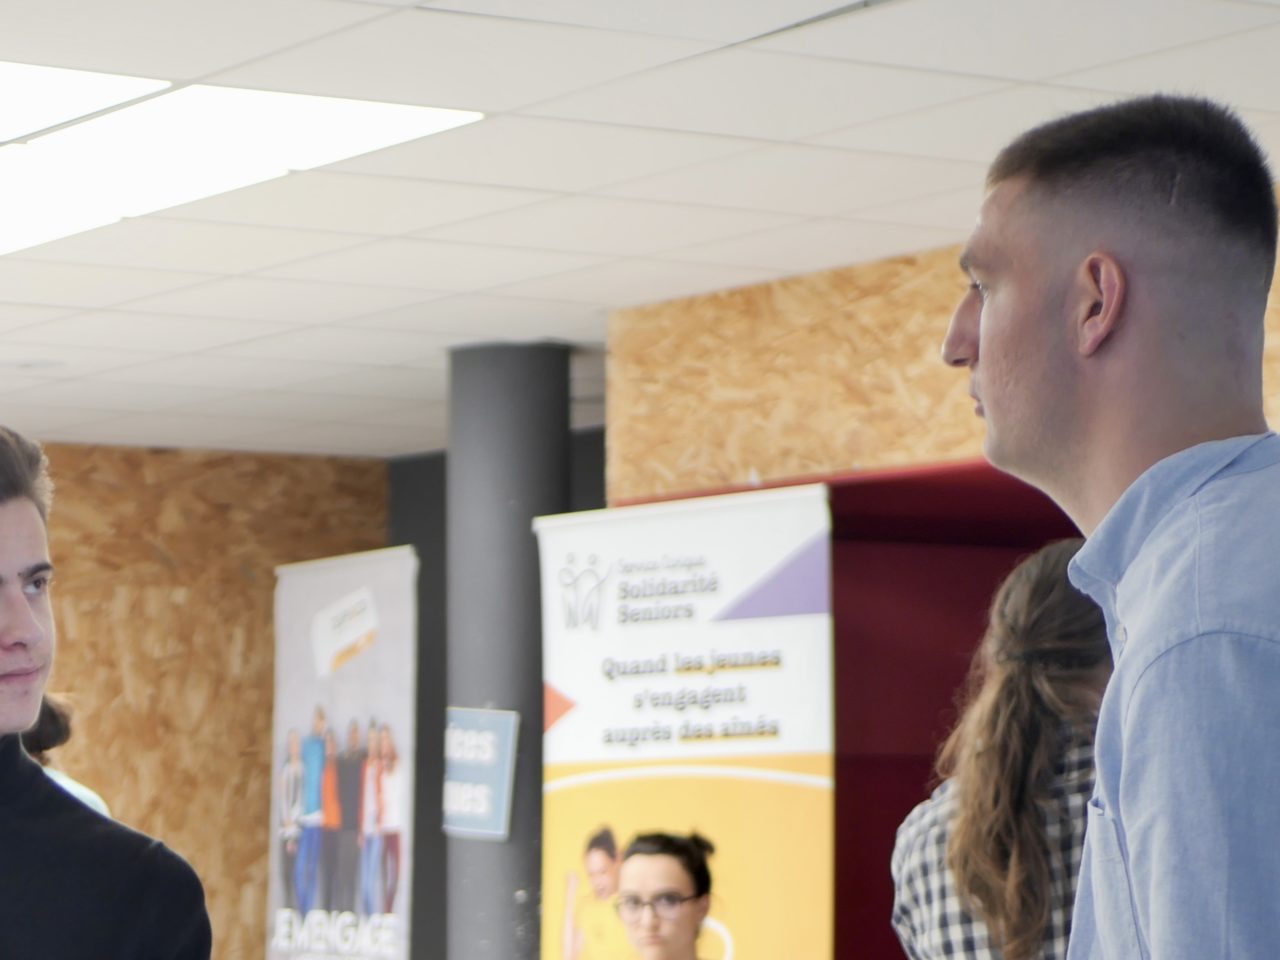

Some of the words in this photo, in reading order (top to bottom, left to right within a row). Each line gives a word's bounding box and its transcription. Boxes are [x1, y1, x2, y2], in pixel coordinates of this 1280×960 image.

[618, 572, 719, 600] Solidarité
[618, 601, 694, 624] Seniors
[602, 654, 668, 681] Quand
[674, 651, 704, 673] les
[709, 648, 782, 675] jeunes
[633, 683, 747, 711] s'engagent
[603, 723, 672, 747] auprès
[679, 719, 714, 740] des
